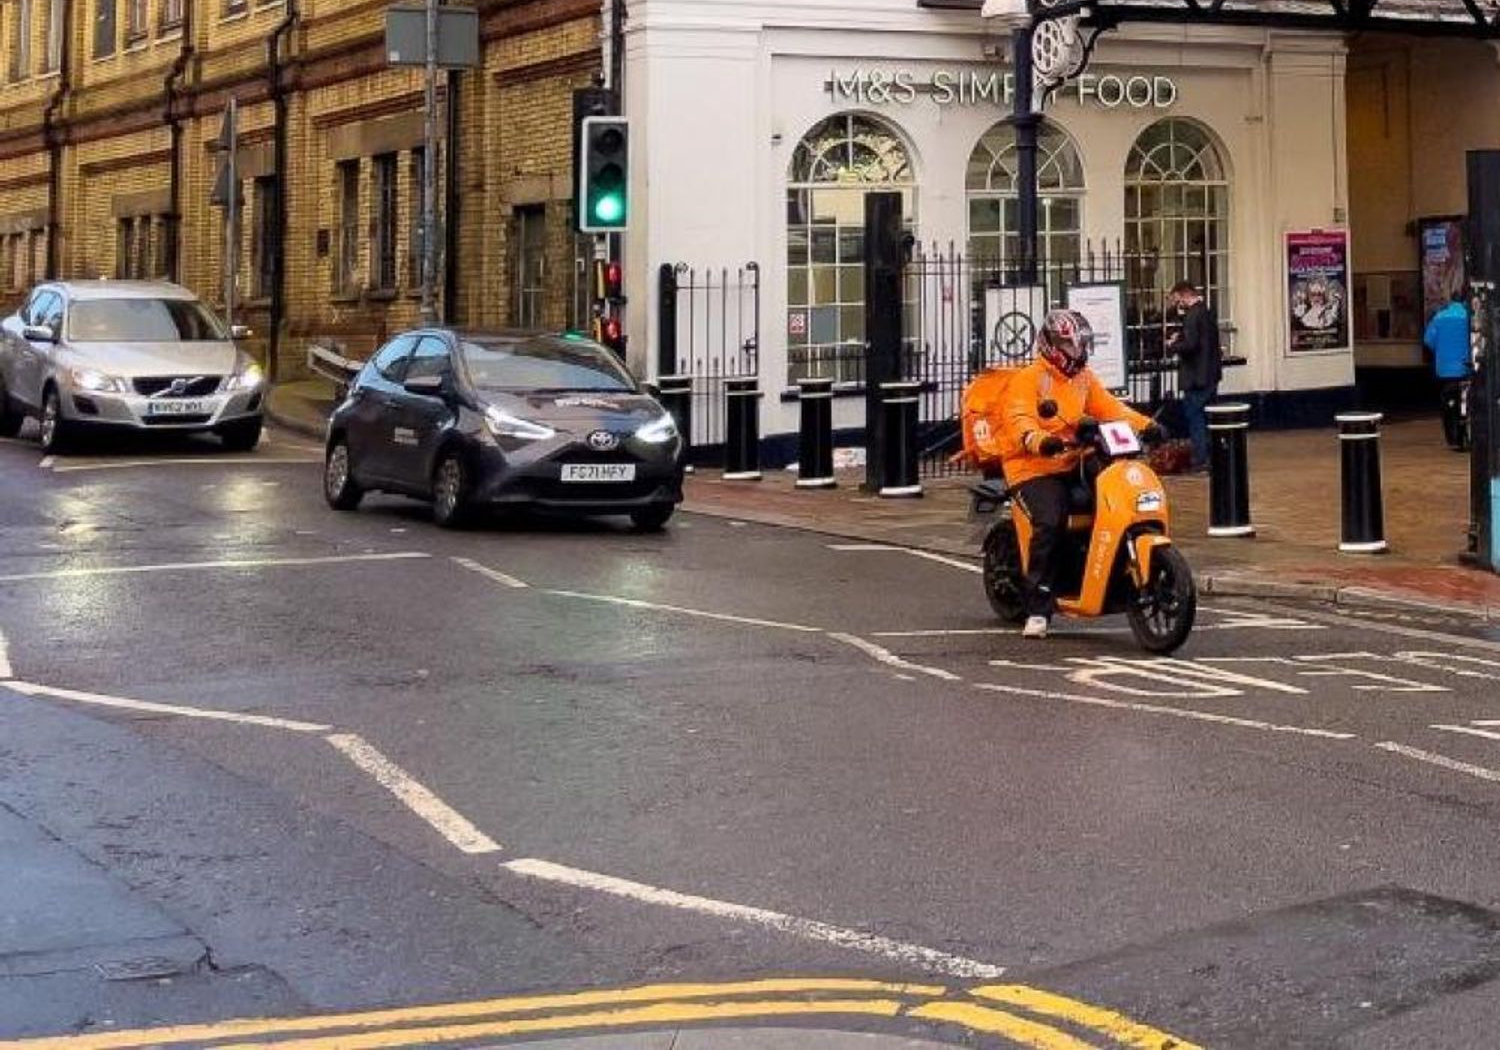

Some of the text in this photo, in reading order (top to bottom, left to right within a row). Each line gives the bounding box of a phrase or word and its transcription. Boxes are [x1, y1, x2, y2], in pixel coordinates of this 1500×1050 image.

[829, 70, 1176, 108] M&S SIMP FOOD
[1110, 429, 1131, 446] L
